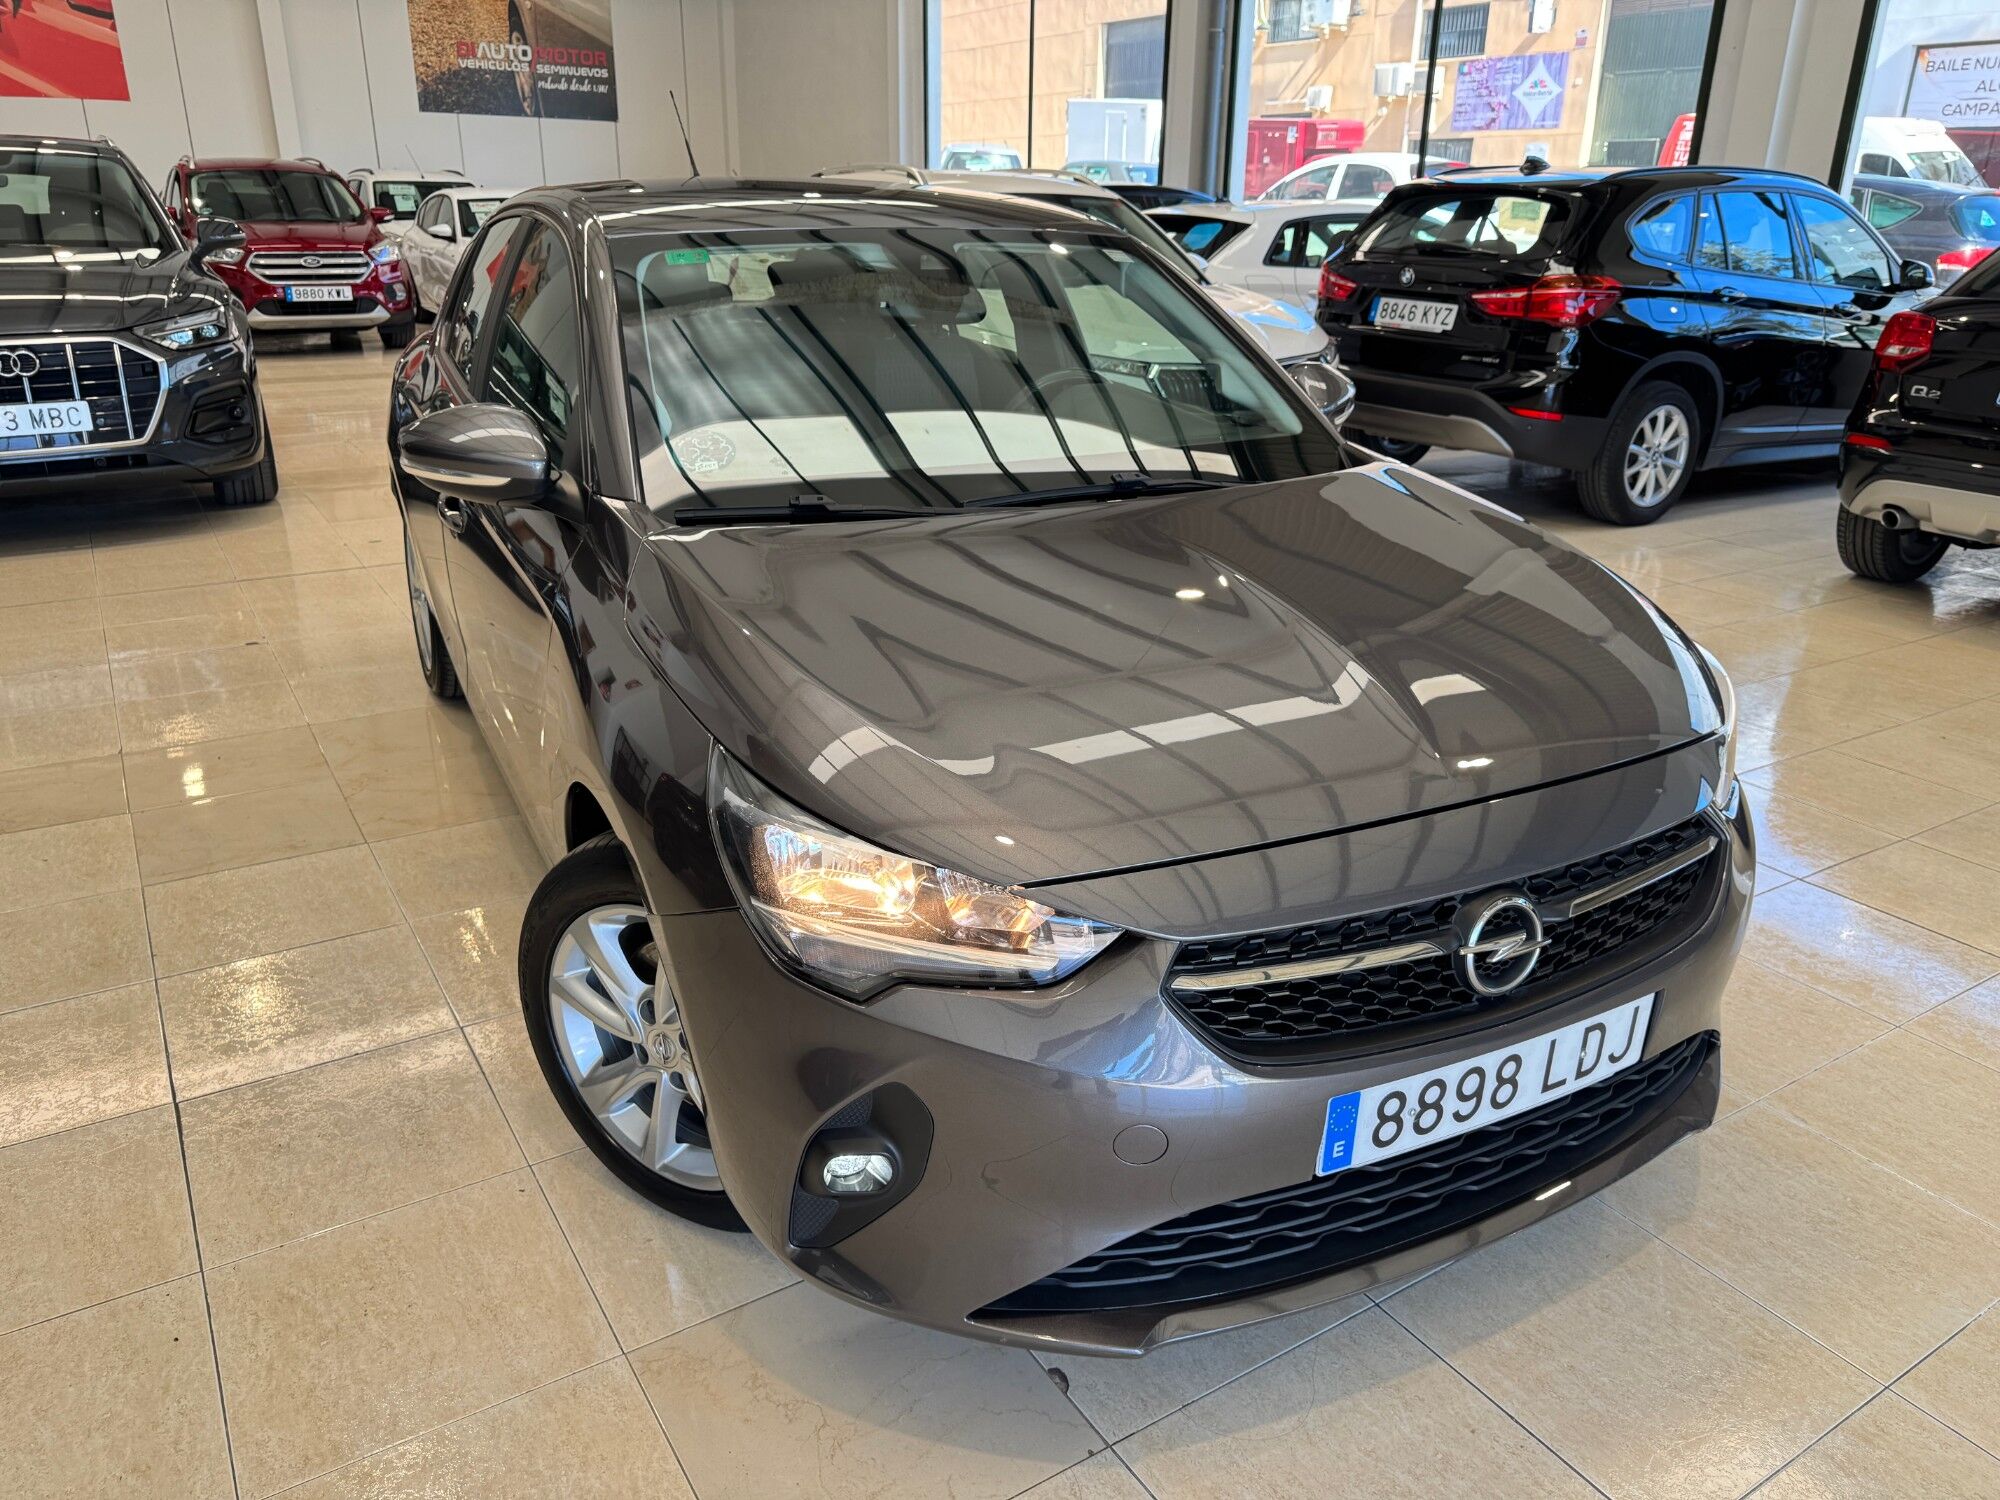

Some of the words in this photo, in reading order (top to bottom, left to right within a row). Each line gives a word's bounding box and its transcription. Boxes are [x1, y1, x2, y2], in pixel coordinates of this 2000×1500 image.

[458, 58, 530, 72] VEHICULOS
[536, 64, 609, 78] SEMINUEVOS
[1925, 58, 1972, 73] BAILE
[294, 288, 325, 299] 9880
[327, 288, 350, 299] KWL
[1380, 302, 1418, 322] 8846
[1420, 305, 1453, 326] KYZ
[1910, 385, 1942, 400] Q2
[28, 406, 82, 430] MBC
[1371, 1053, 1523, 1149] 8898
[1541, 1005, 1640, 1095] LDJ
[1332, 1140, 1346, 1159] E
